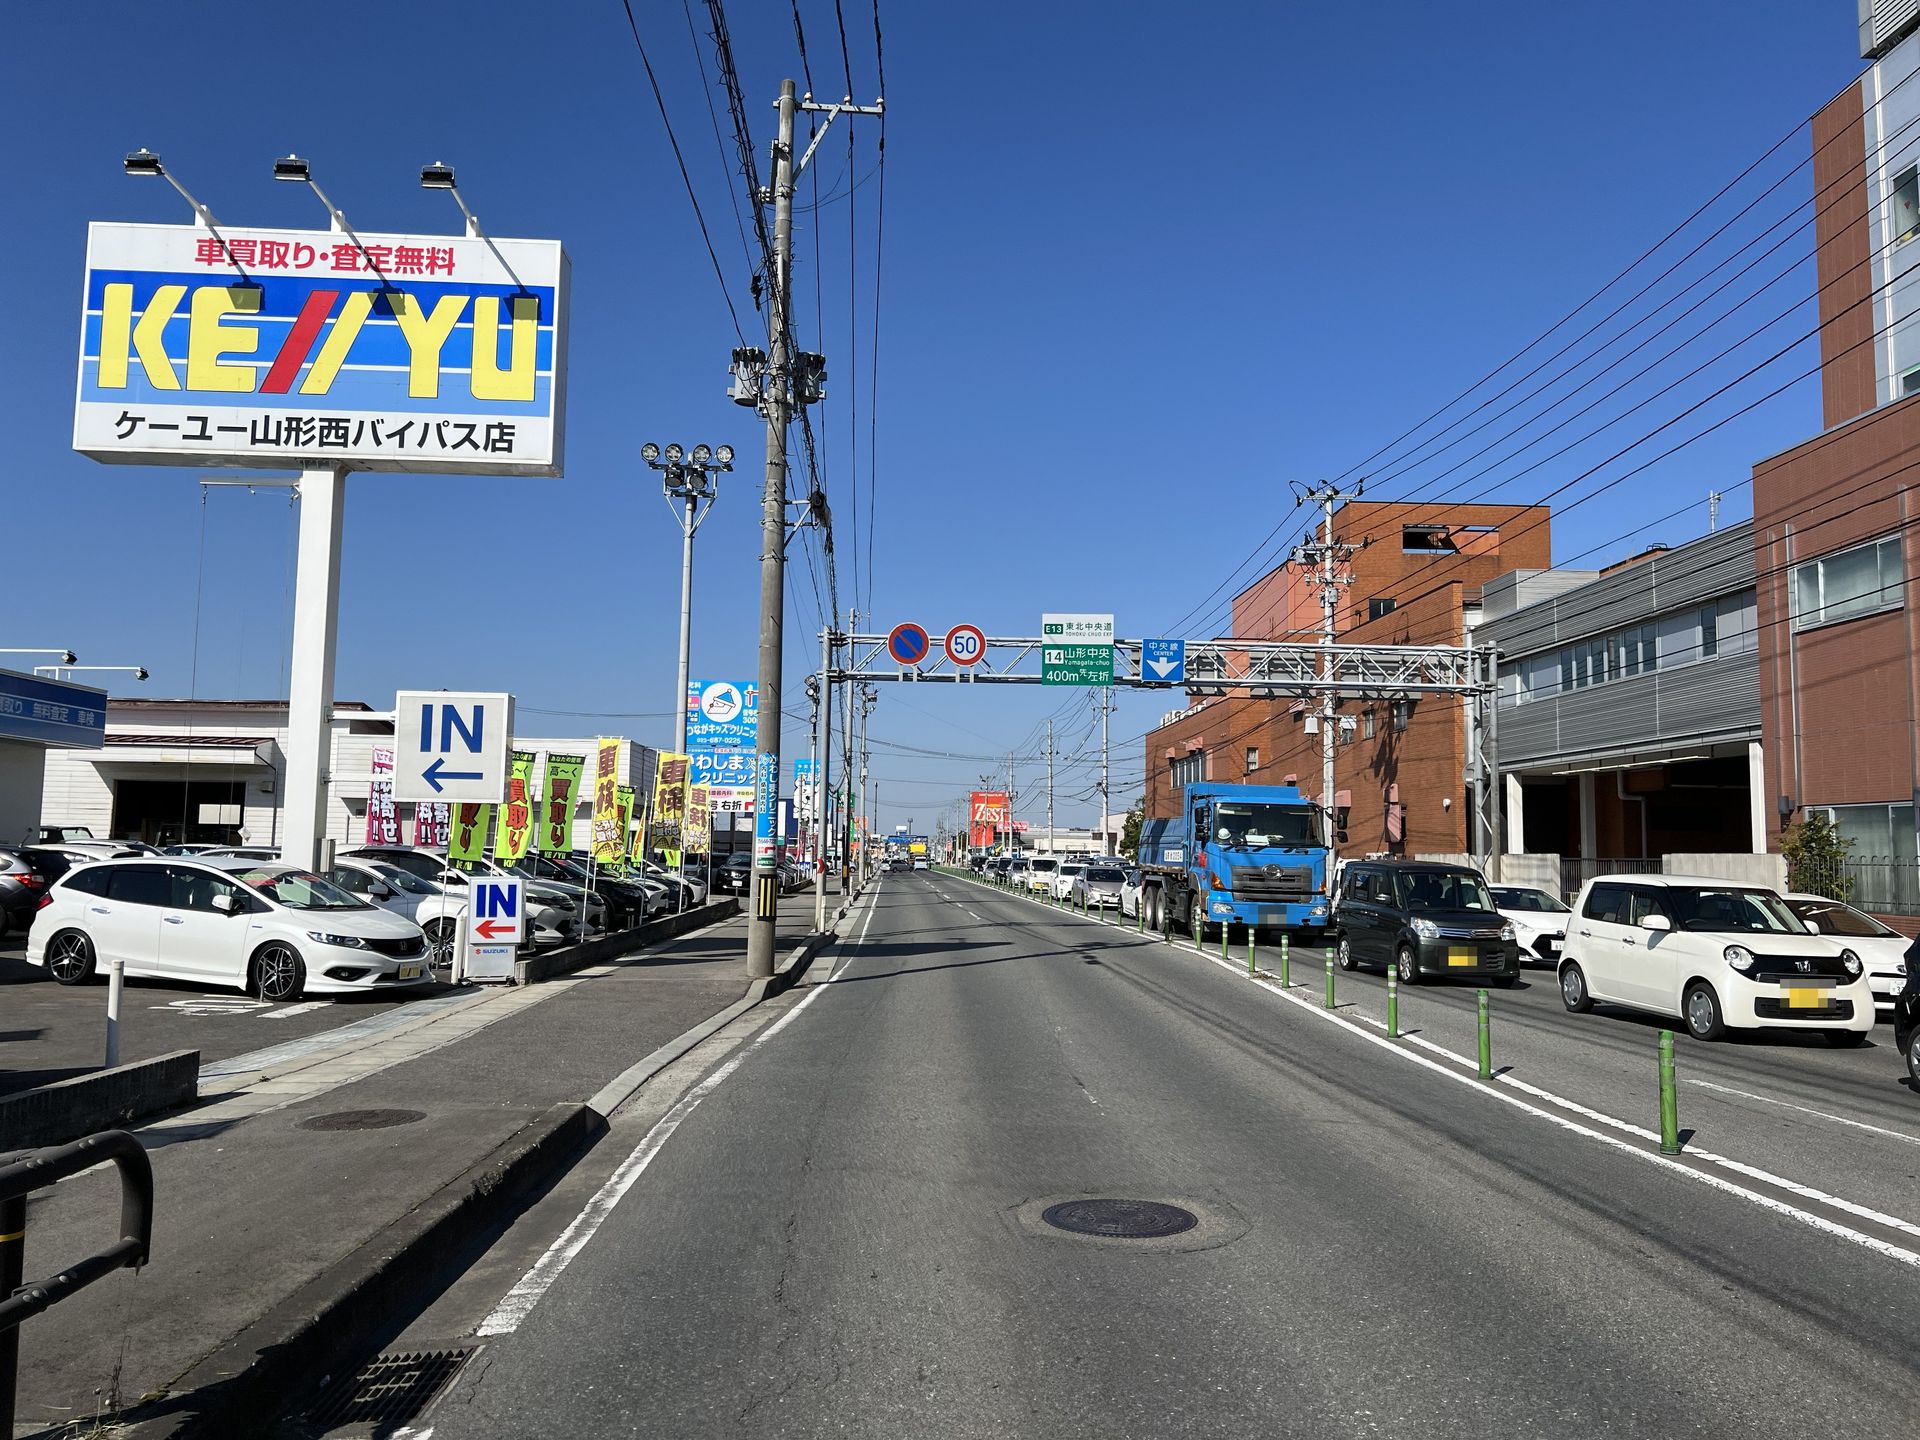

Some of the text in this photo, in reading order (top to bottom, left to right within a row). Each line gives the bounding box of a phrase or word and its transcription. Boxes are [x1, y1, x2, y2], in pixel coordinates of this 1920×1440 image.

[195, 237, 457, 277] 車買取り・査定無料
[114, 410, 516, 454] ケーユー山形西バイパス店
[1046, 625, 1062, 633] E13
[1066, 622, 1112, 631] 東北中央道
[955, 636, 976, 654] 50
[1064, 648, 1110, 658] 山形中央
[1149, 642, 1179, 651] 中央線
[1047, 651, 1062, 662] 14
[420, 703, 484, 753] IN
[597, 744, 618, 815] 車検
[660, 759, 689, 813] 車検
[549, 778, 572, 849] 買取り
[721, 800, 742, 811] 右折
[974, 803, 1004, 822] ZEST
[476, 884, 518, 918] IN
